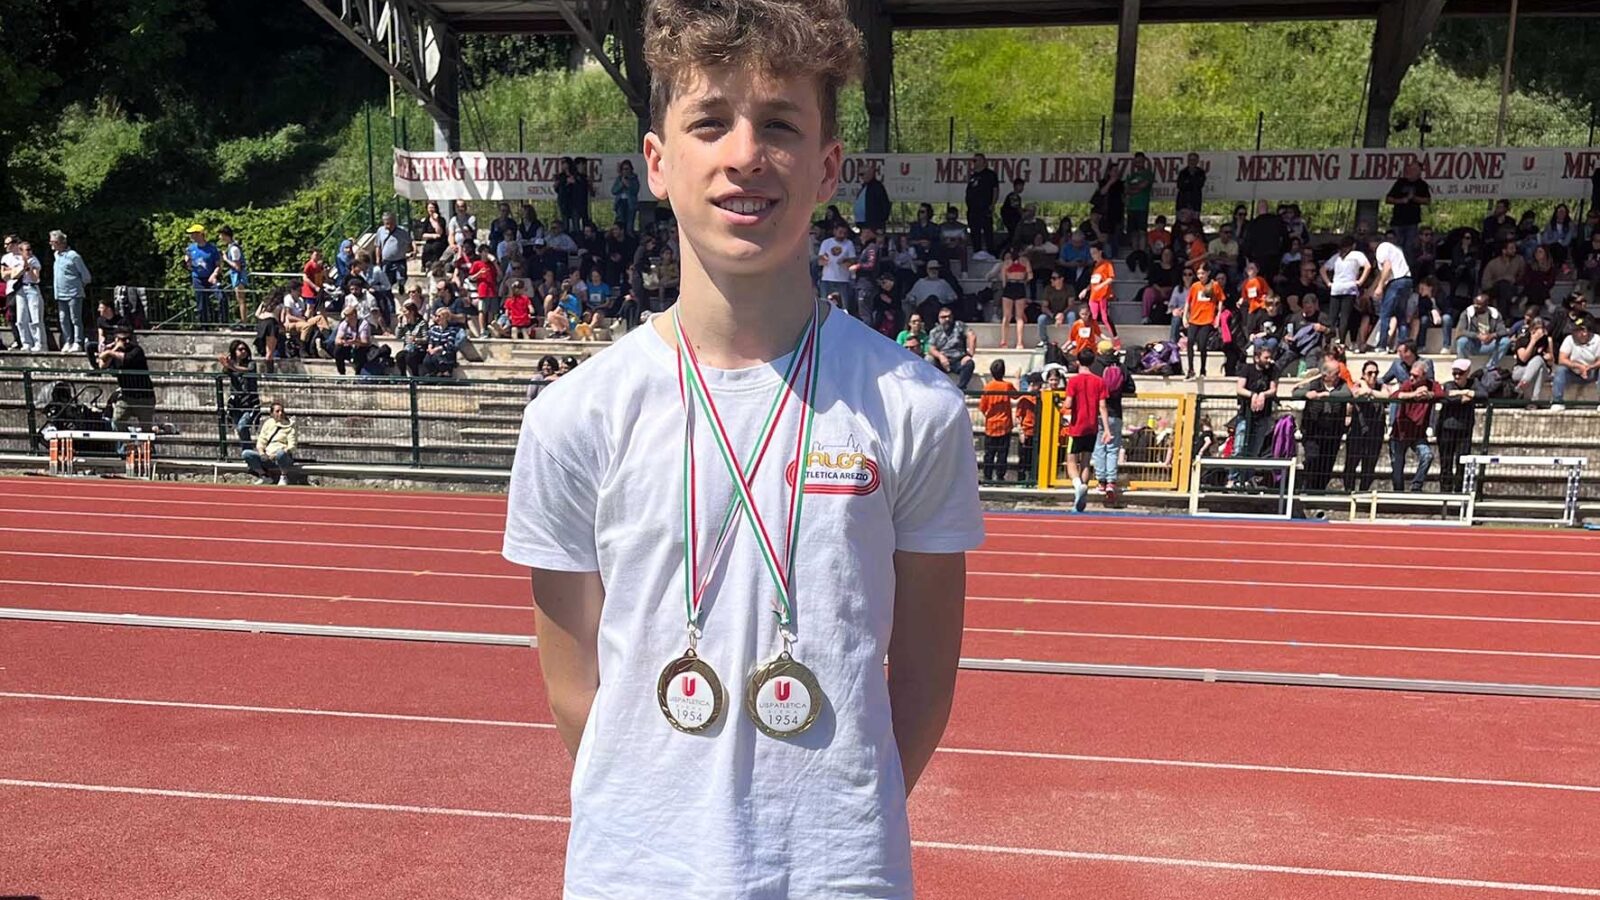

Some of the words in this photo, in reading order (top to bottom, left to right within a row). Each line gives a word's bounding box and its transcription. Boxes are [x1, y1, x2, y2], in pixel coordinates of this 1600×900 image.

[473, 157, 602, 182] LIBERAZIE
[934, 159, 1032, 183] MEING
[1040, 157, 1183, 183] LIBERZNE
[1236, 154, 1341, 181] MEETING
[1523, 157, 1535, 171] U
[1461, 183, 1500, 195] APRILE
[805, 471, 838, 480] TLETICA
[839, 472, 869, 482] AREZZO
[681, 676, 696, 698] U
[774, 680, 791, 702] U
[676, 708, 703, 722] 1954
[768, 714, 799, 726] 1954
